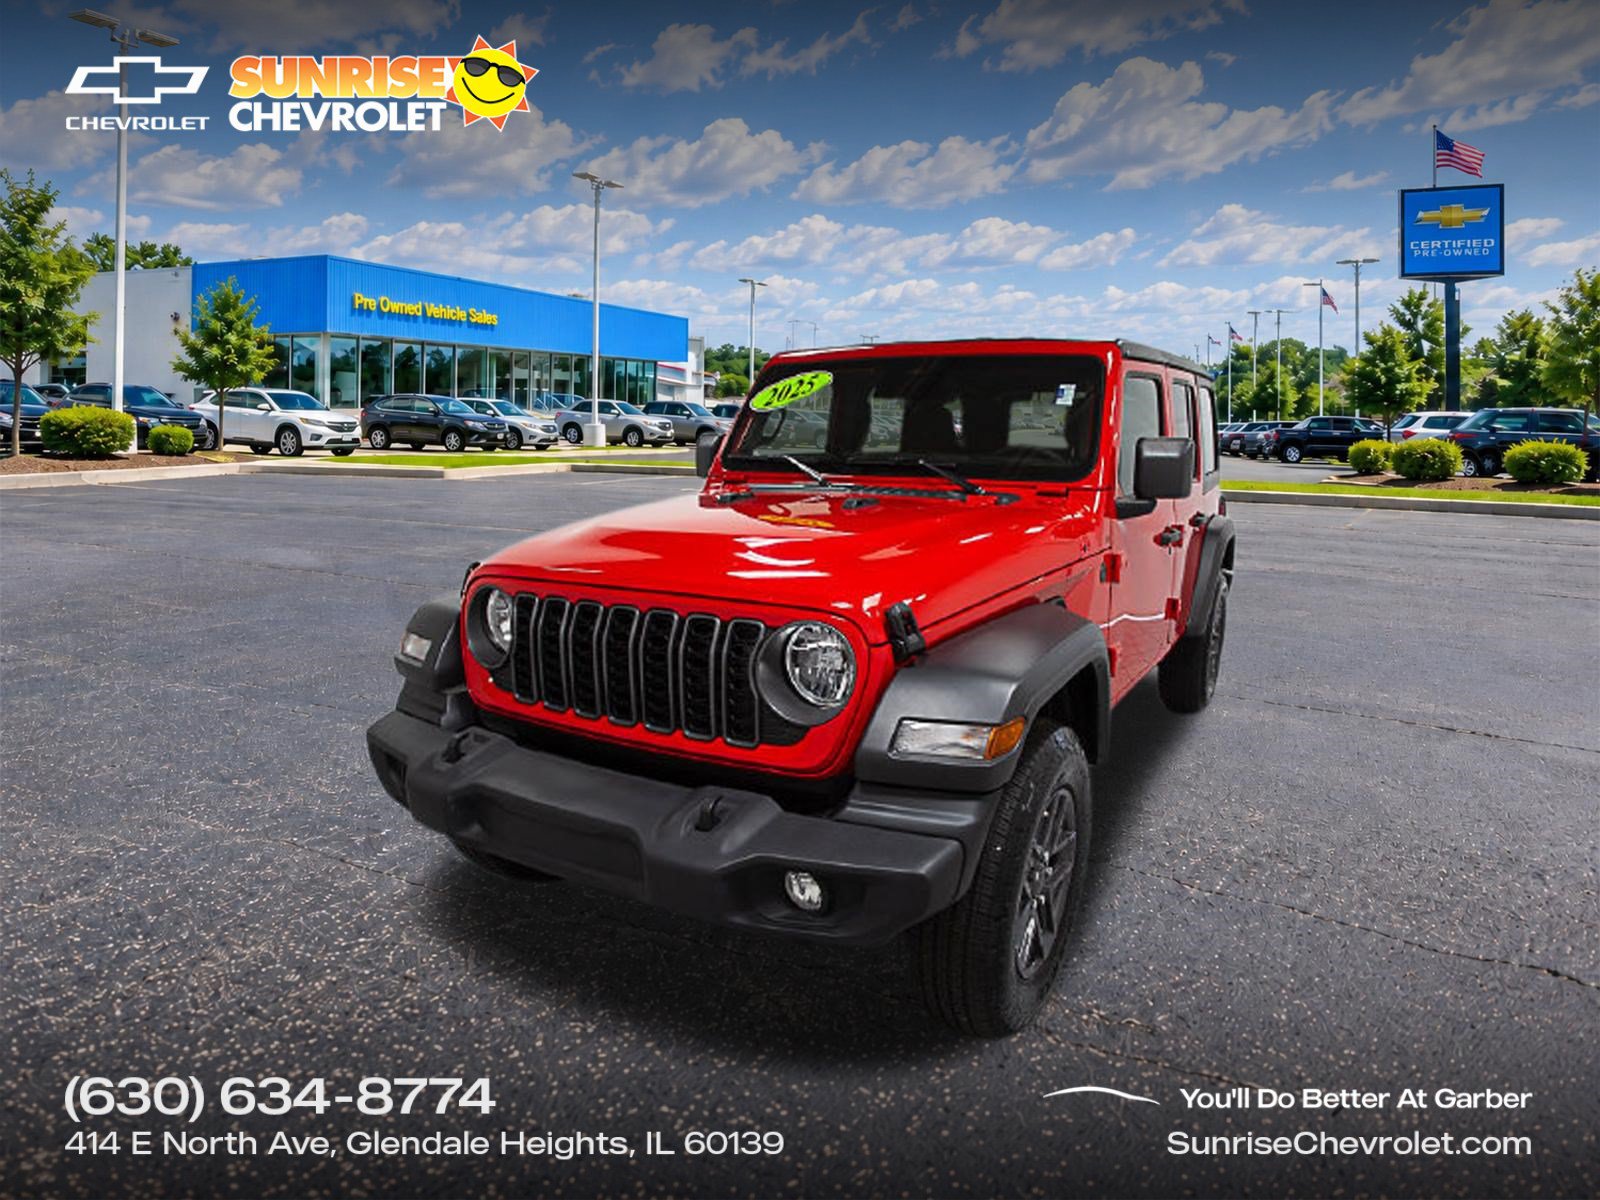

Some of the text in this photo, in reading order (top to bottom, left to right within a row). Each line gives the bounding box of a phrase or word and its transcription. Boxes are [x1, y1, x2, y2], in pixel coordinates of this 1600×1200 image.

[1410, 238, 1495, 250] CERTIFIED
[1414, 248, 1490, 257] PRE-OWNED
[353, 293, 499, 325] Pre Owned Vehicle Sales
[763, 374, 820, 407] 2025
